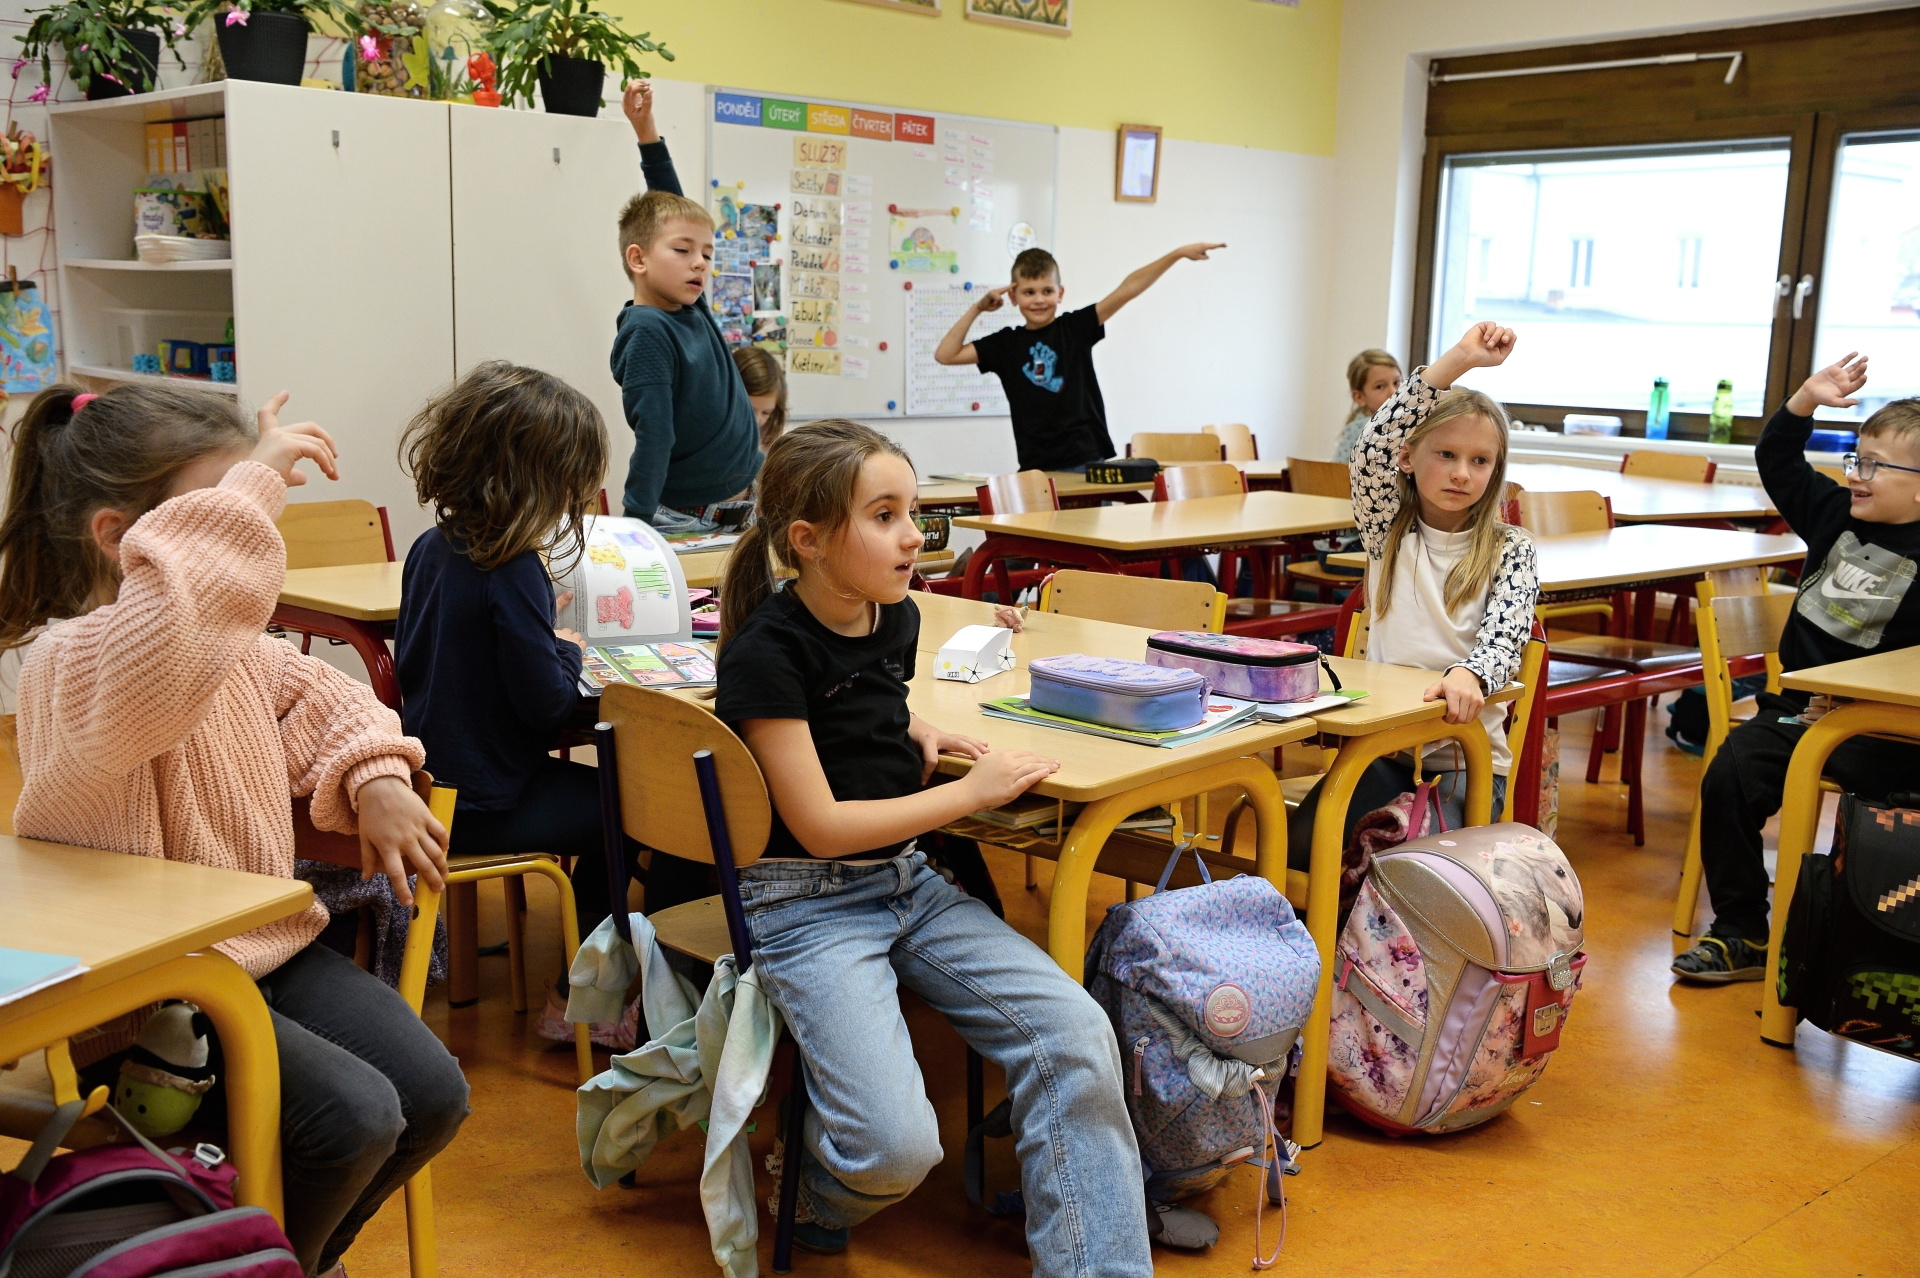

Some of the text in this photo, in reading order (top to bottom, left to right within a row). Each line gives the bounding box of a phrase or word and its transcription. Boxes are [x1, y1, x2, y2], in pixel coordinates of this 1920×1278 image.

[716, 100, 760, 119] PONDĚLÍ
[769, 104, 801, 122] ÚTERÝ
[811, 110, 846, 127] STŘEDA
[852, 114, 891, 134] ČTVRTEK
[902, 117, 928, 136] PÁTEK
[1834, 560, 1885, 596] NIKE
